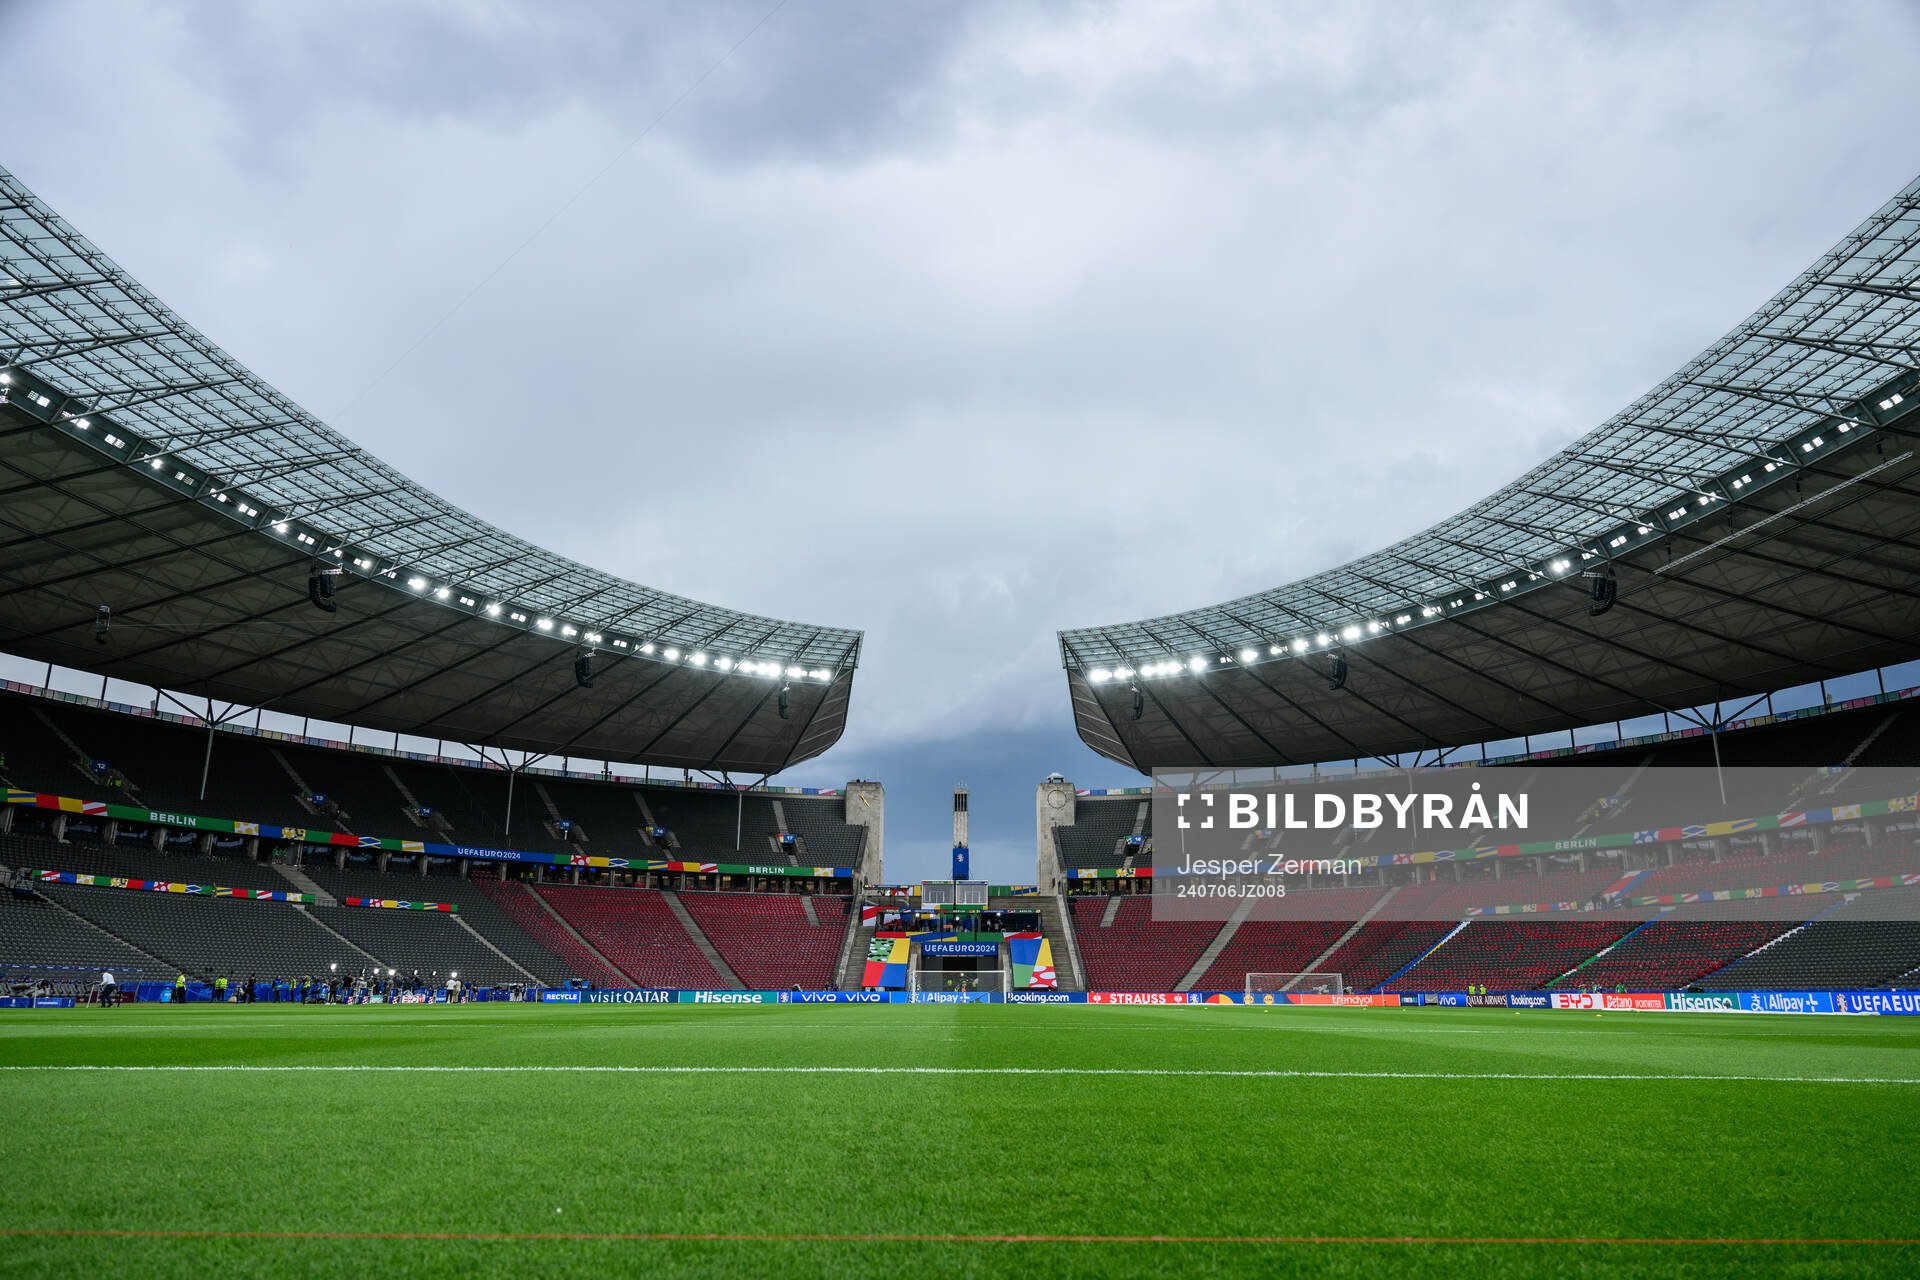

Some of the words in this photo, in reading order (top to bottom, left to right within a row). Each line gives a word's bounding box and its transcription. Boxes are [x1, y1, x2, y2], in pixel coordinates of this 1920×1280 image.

[150, 812, 196, 826] BERLIN
[1555, 839, 1597, 850] BERLIN
[694, 992, 762, 1003] Hisense
[802, 992, 836, 1002] vivo
[846, 992, 880, 1002] vivo
[1008, 992, 1070, 1004] Booking.com
[1110, 993, 1166, 1004] STRAUSS
[1332, 994, 1372, 1006] trendyol
[1440, 994, 1456, 1006] vivo
[1466, 994, 1484, 1008] QATAR
[1484, 994, 1506, 1006] AIRWAYS
[1510, 994, 1546, 1008] Booking.com
[1559, 994, 1593, 1008] BYD
[1606, 995, 1632, 1008] Betano
[1670, 993, 1732, 1011] Hisense
